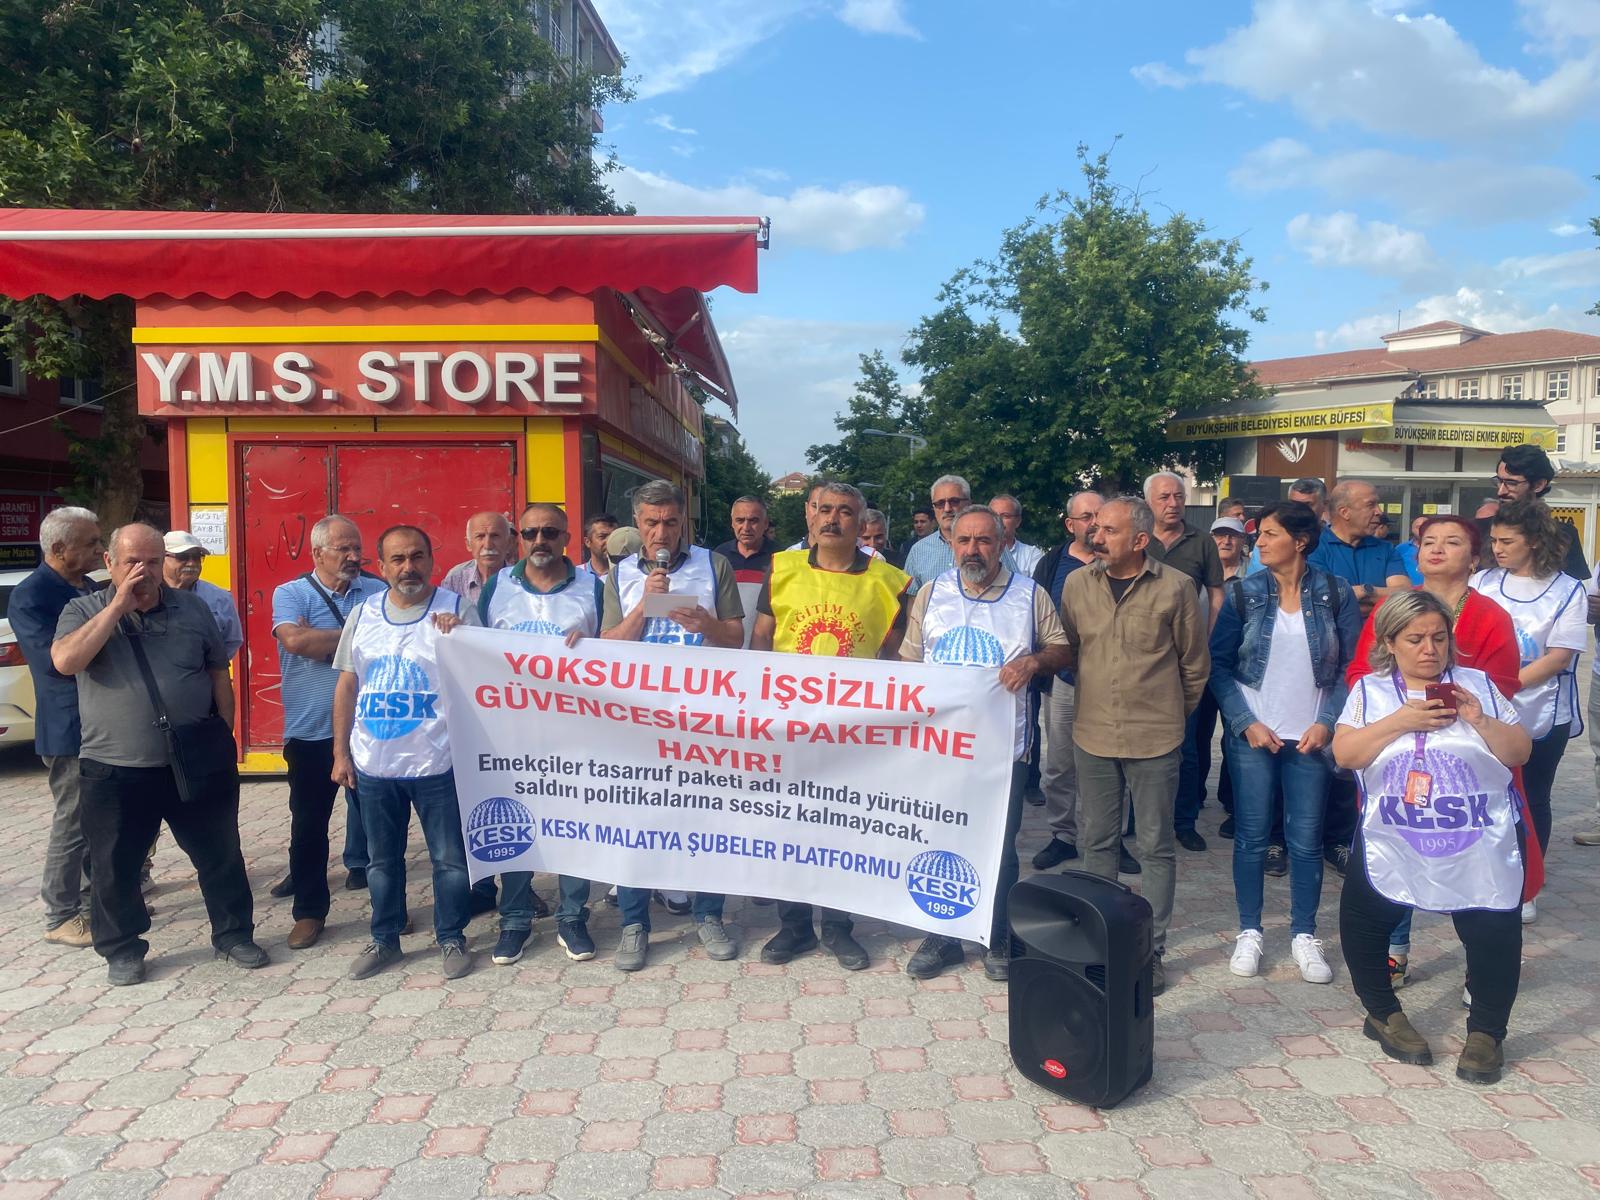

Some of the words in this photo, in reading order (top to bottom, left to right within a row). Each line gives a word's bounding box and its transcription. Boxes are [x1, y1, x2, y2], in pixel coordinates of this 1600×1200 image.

[141, 351, 338, 403] Y.M.S.
[357, 351, 583, 403] STORE
[1241, 414, 1292, 431] BELEDİYESİ
[1294, 415, 1327, 427] EKMEK
[1330, 408, 1366, 424] BÜFESİ
[1438, 427, 1476, 442] BELEDİYESİ
[1477, 431, 1500, 442] EKMEK
[1501, 429, 1525, 443] BÜFESİ
[789, 602, 843, 633] EĞİTİM
[847, 612, 866, 643] SEN
[504, 652, 747, 704] YOKSULLUK,
[760, 667, 936, 717] İŞSİZLİK,
[475, 681, 775, 741] GÜVENCESİZLİK
[786, 719, 976, 760] PAKETİNE
[658, 739, 782, 773] HAYIR!
[478, 754, 584, 778] Emekçiler
[588, 759, 673, 782] tasarruf
[678, 767, 743, 789] paketi
[749, 778, 781, 794] adı
[787, 780, 862, 806] altında
[866, 792, 969, 827] yürütülen
[514, 778, 578, 799] saldırı
[584, 785, 723, 811] politikalarına
[729, 798, 792, 820] sessiz
[796, 804, 929, 845] kalmayacak.
[1378, 793, 1495, 830] KESK
[468, 825, 534, 851] KESK
[487, 846, 516, 860] 1995
[541, 818, 591, 841] KESK
[595, 825, 682, 851] MALATYA
[687, 831, 777, 860] ŞUBELER
[782, 843, 901, 880] PLATFORMU
[1418, 837, 1457, 851] 1995
[908, 873, 978, 907] KESK
[926, 900, 955, 917] 1995
